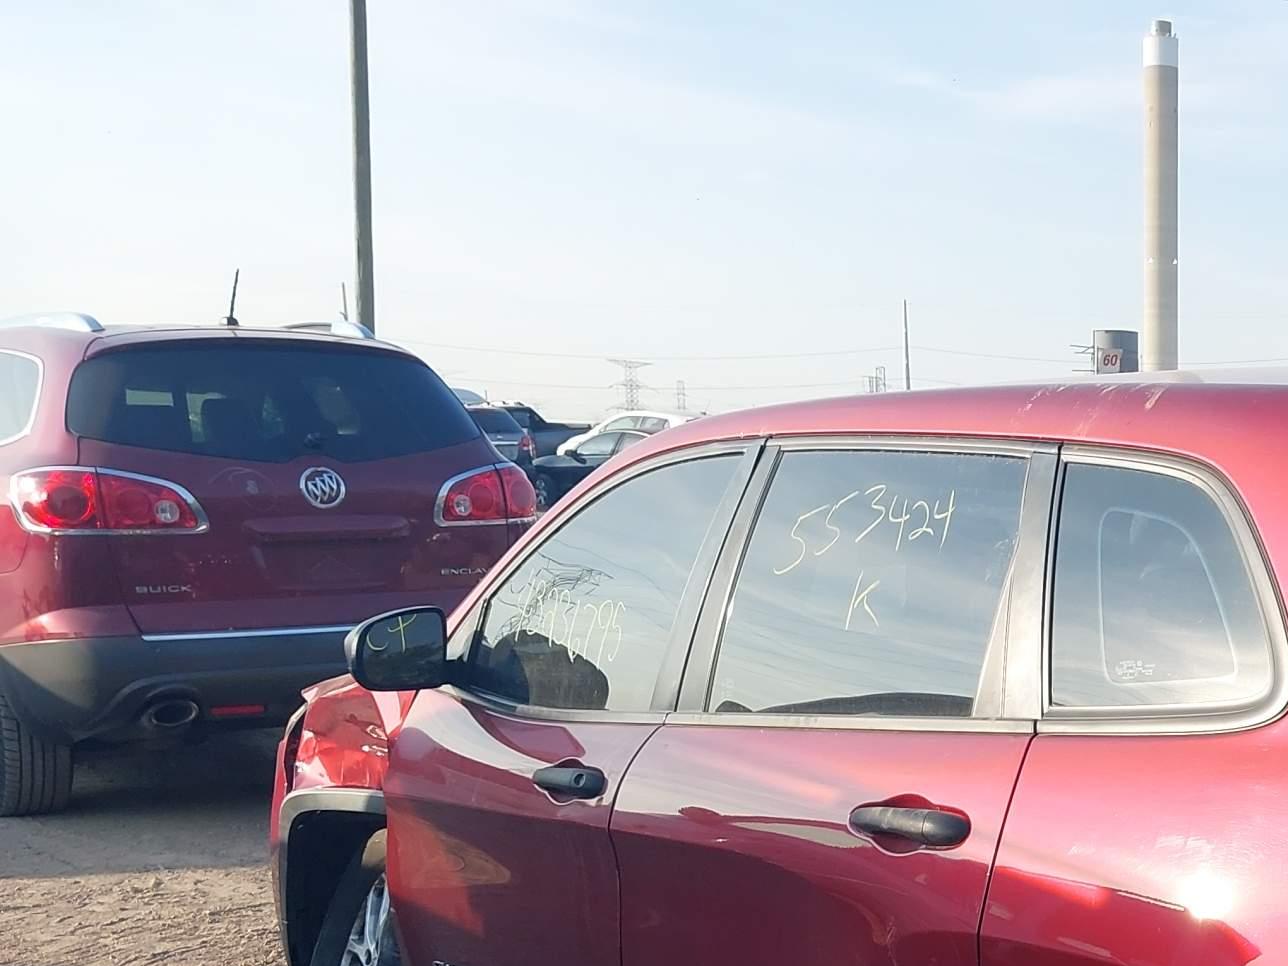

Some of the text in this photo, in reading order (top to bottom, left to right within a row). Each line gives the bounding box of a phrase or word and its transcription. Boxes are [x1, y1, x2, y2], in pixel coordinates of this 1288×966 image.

[1102, 353, 1119, 367] 60
[772, 483, 957, 575] 553424
[440, 567, 490, 576] ENCLAV
[135, 584, 192, 594] BUICK
[844, 569, 883, 631] K
